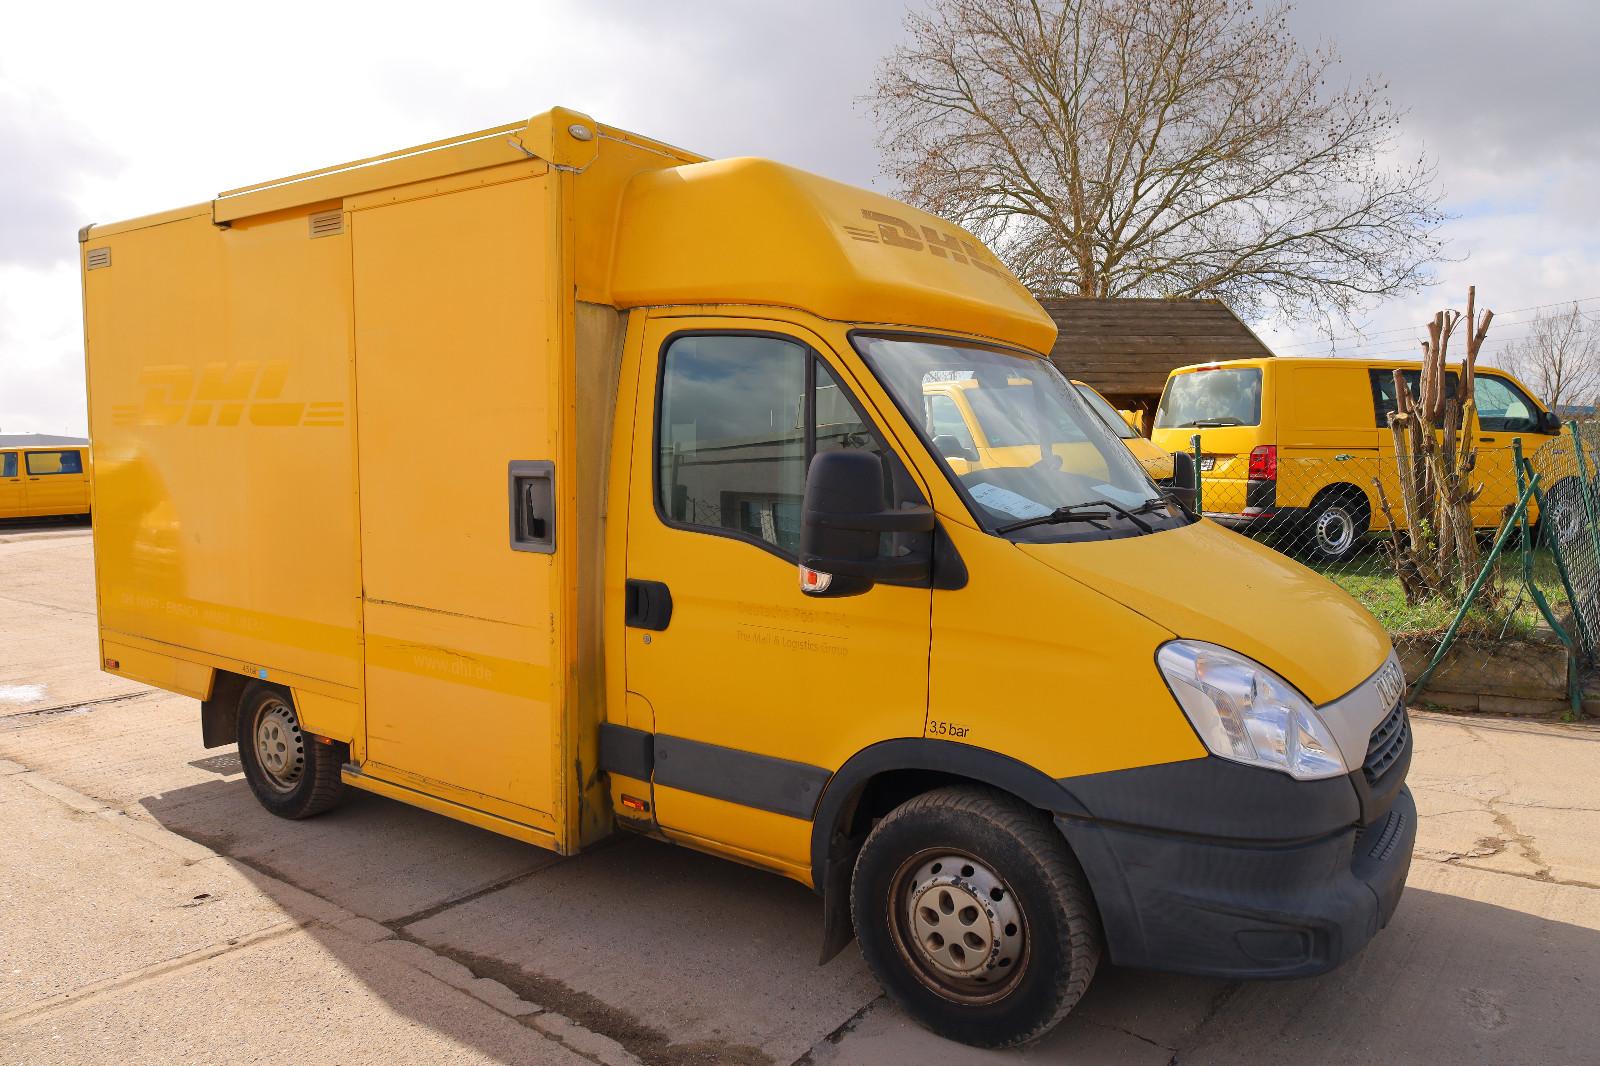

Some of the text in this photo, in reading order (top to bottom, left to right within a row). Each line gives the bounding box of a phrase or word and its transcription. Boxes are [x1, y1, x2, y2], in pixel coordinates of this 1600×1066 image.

[861, 208, 1001, 278] DHL
[138, 360, 305, 427] DHL
[782, 636, 819, 652] Logistics
[414, 654, 493, 681] www.dhl.de
[930, 720, 969, 737] 3,5 bar
